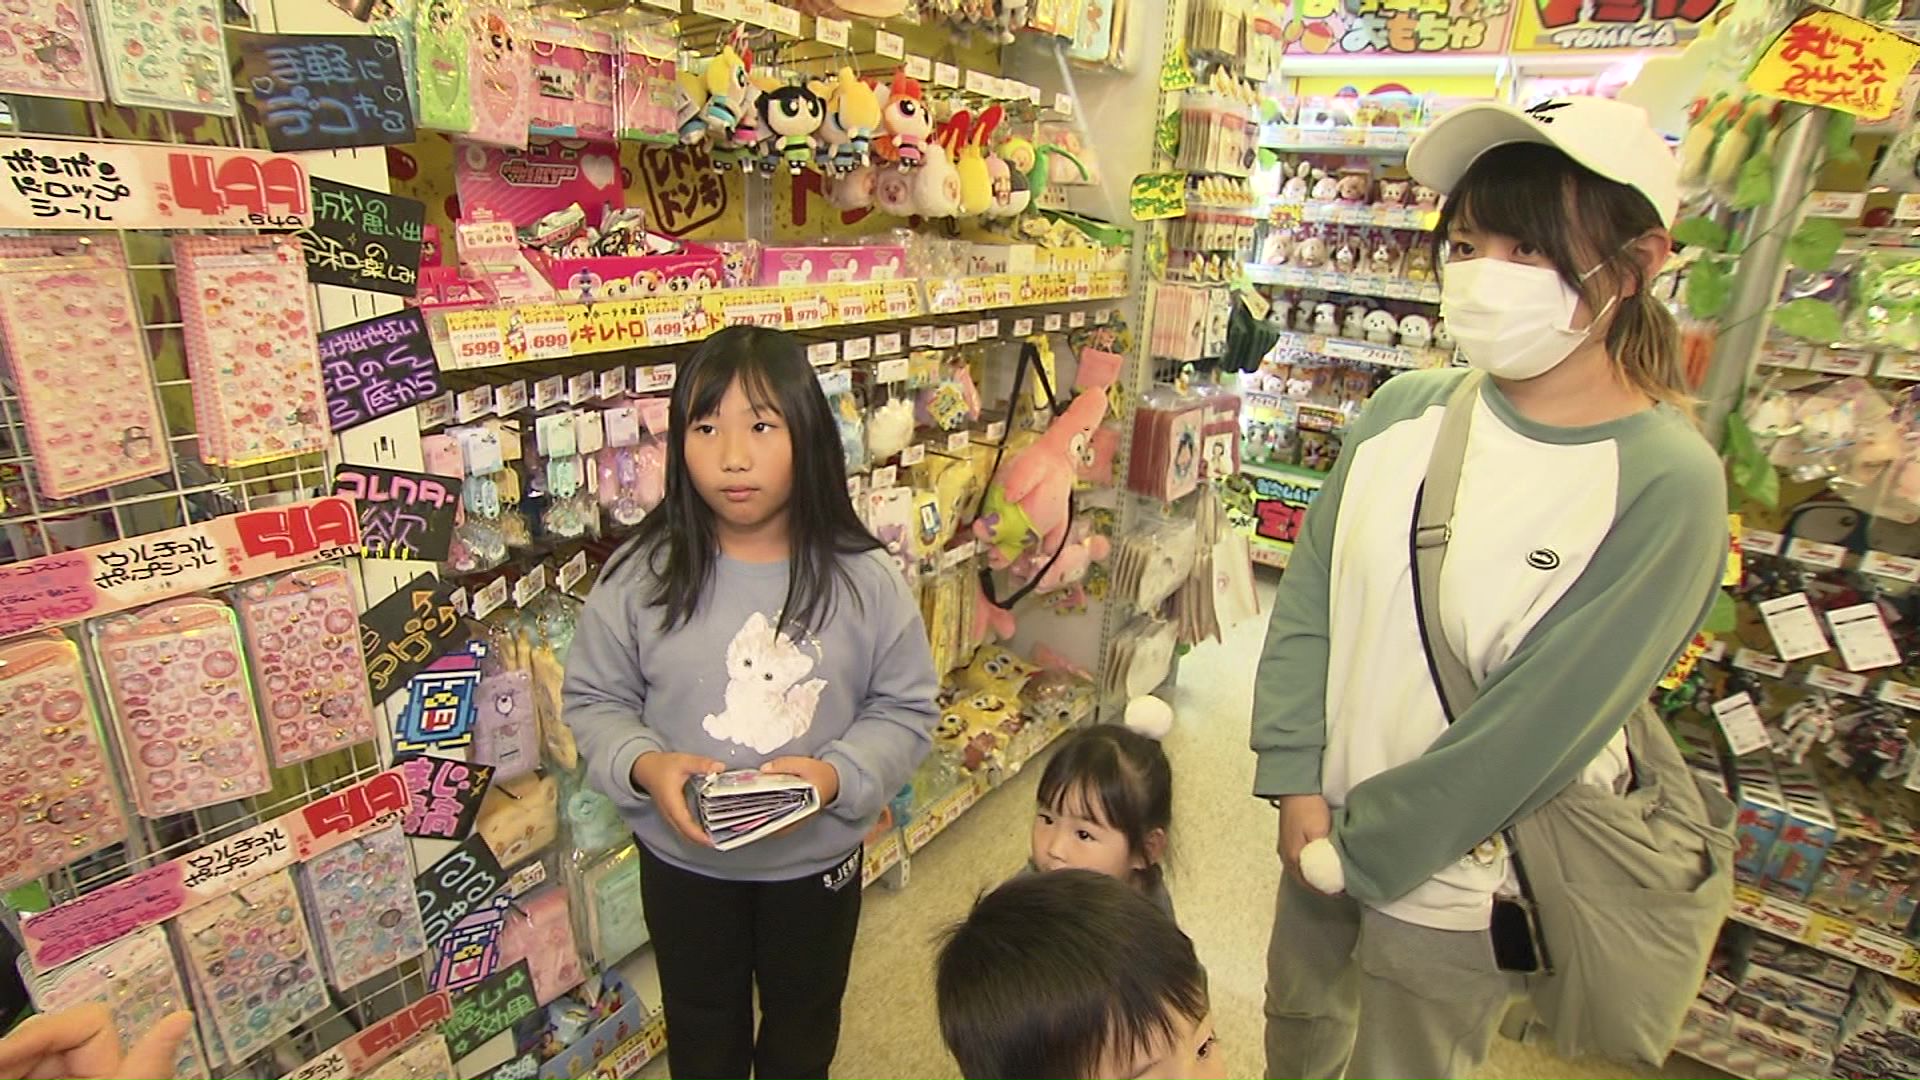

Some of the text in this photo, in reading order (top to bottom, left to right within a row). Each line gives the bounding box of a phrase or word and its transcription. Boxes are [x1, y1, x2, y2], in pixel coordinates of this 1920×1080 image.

[1340, 11, 1487, 52] おもちゃ
[1553, 21, 1678, 49] TOMICA
[266, 42, 385, 86] 手軽に
[11, 175, 130, 202] ドロップ
[168, 153, 307, 216] 499
[30, 198, 114, 221] シール
[659, 173, 719, 227] ドンキ
[533, 333, 568, 348] 699
[654, 322, 681, 336] 499
[462, 340, 500, 357] 599
[403, 757, 471, 799] まじ
[1830, 936, 1897, 966] 4,799
